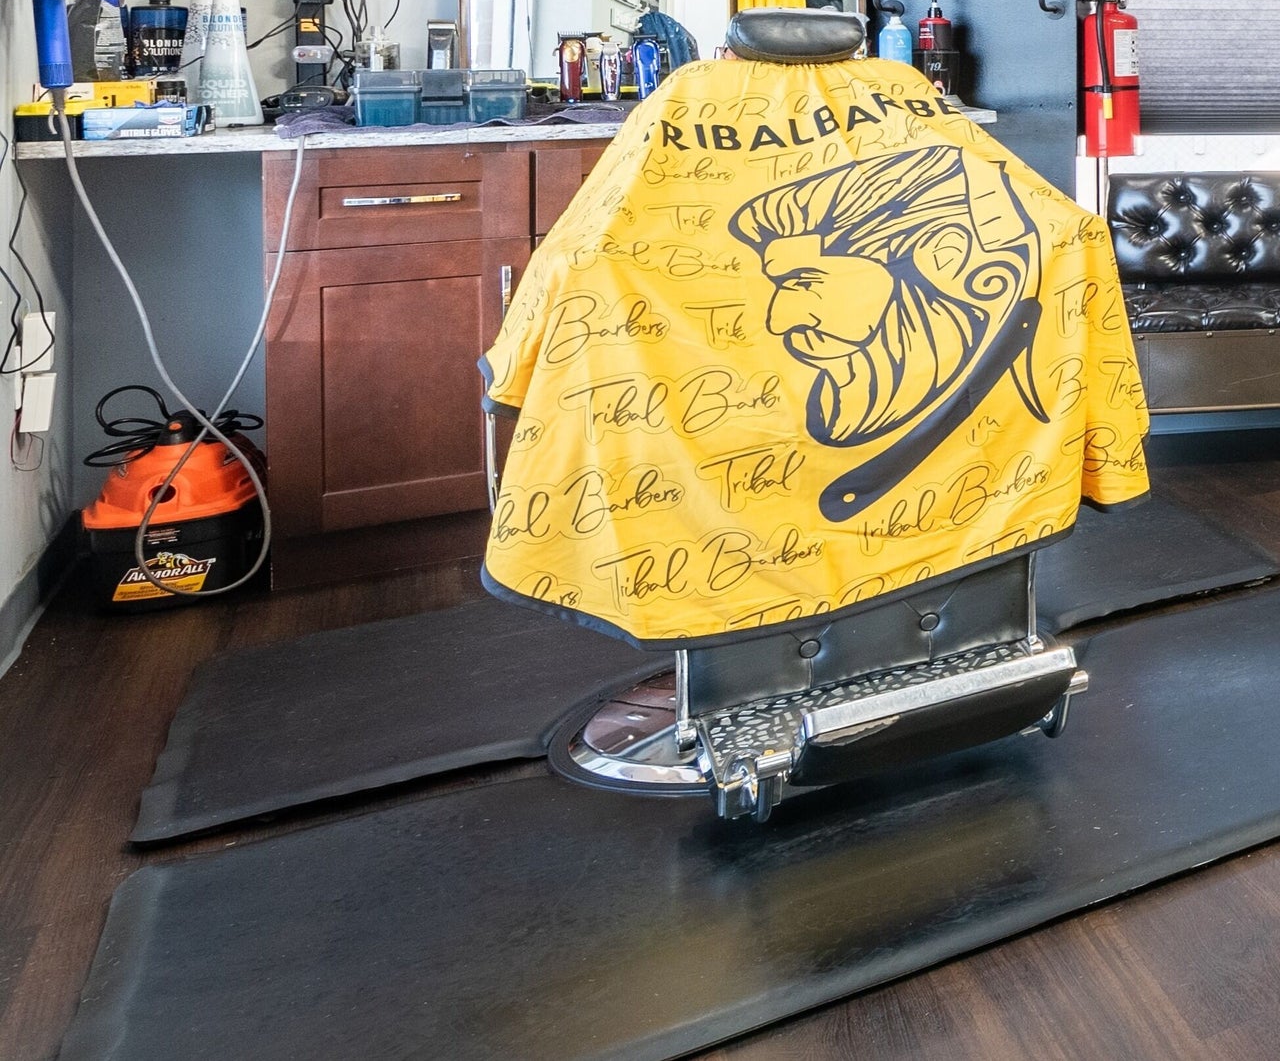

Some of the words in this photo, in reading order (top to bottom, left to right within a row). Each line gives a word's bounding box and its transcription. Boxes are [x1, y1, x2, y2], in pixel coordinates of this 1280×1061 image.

[143, 39, 183, 48] BLONDE
[151, 129, 180, 137] GLOVES
[645, 92, 963, 153] RIBALBARBE
[1050, 216, 1107, 250] arbers
[545, 295, 668, 364] Barbers
[563, 379, 668, 438] Tribal
[680, 370, 780, 434] Barb
[493, 491, 551, 539] bal
[564, 469, 682, 534] Barbers
[700, 448, 805, 508] Tribal
[947, 455, 1048, 525] Barbers
[702, 529, 822, 591] Barbers
